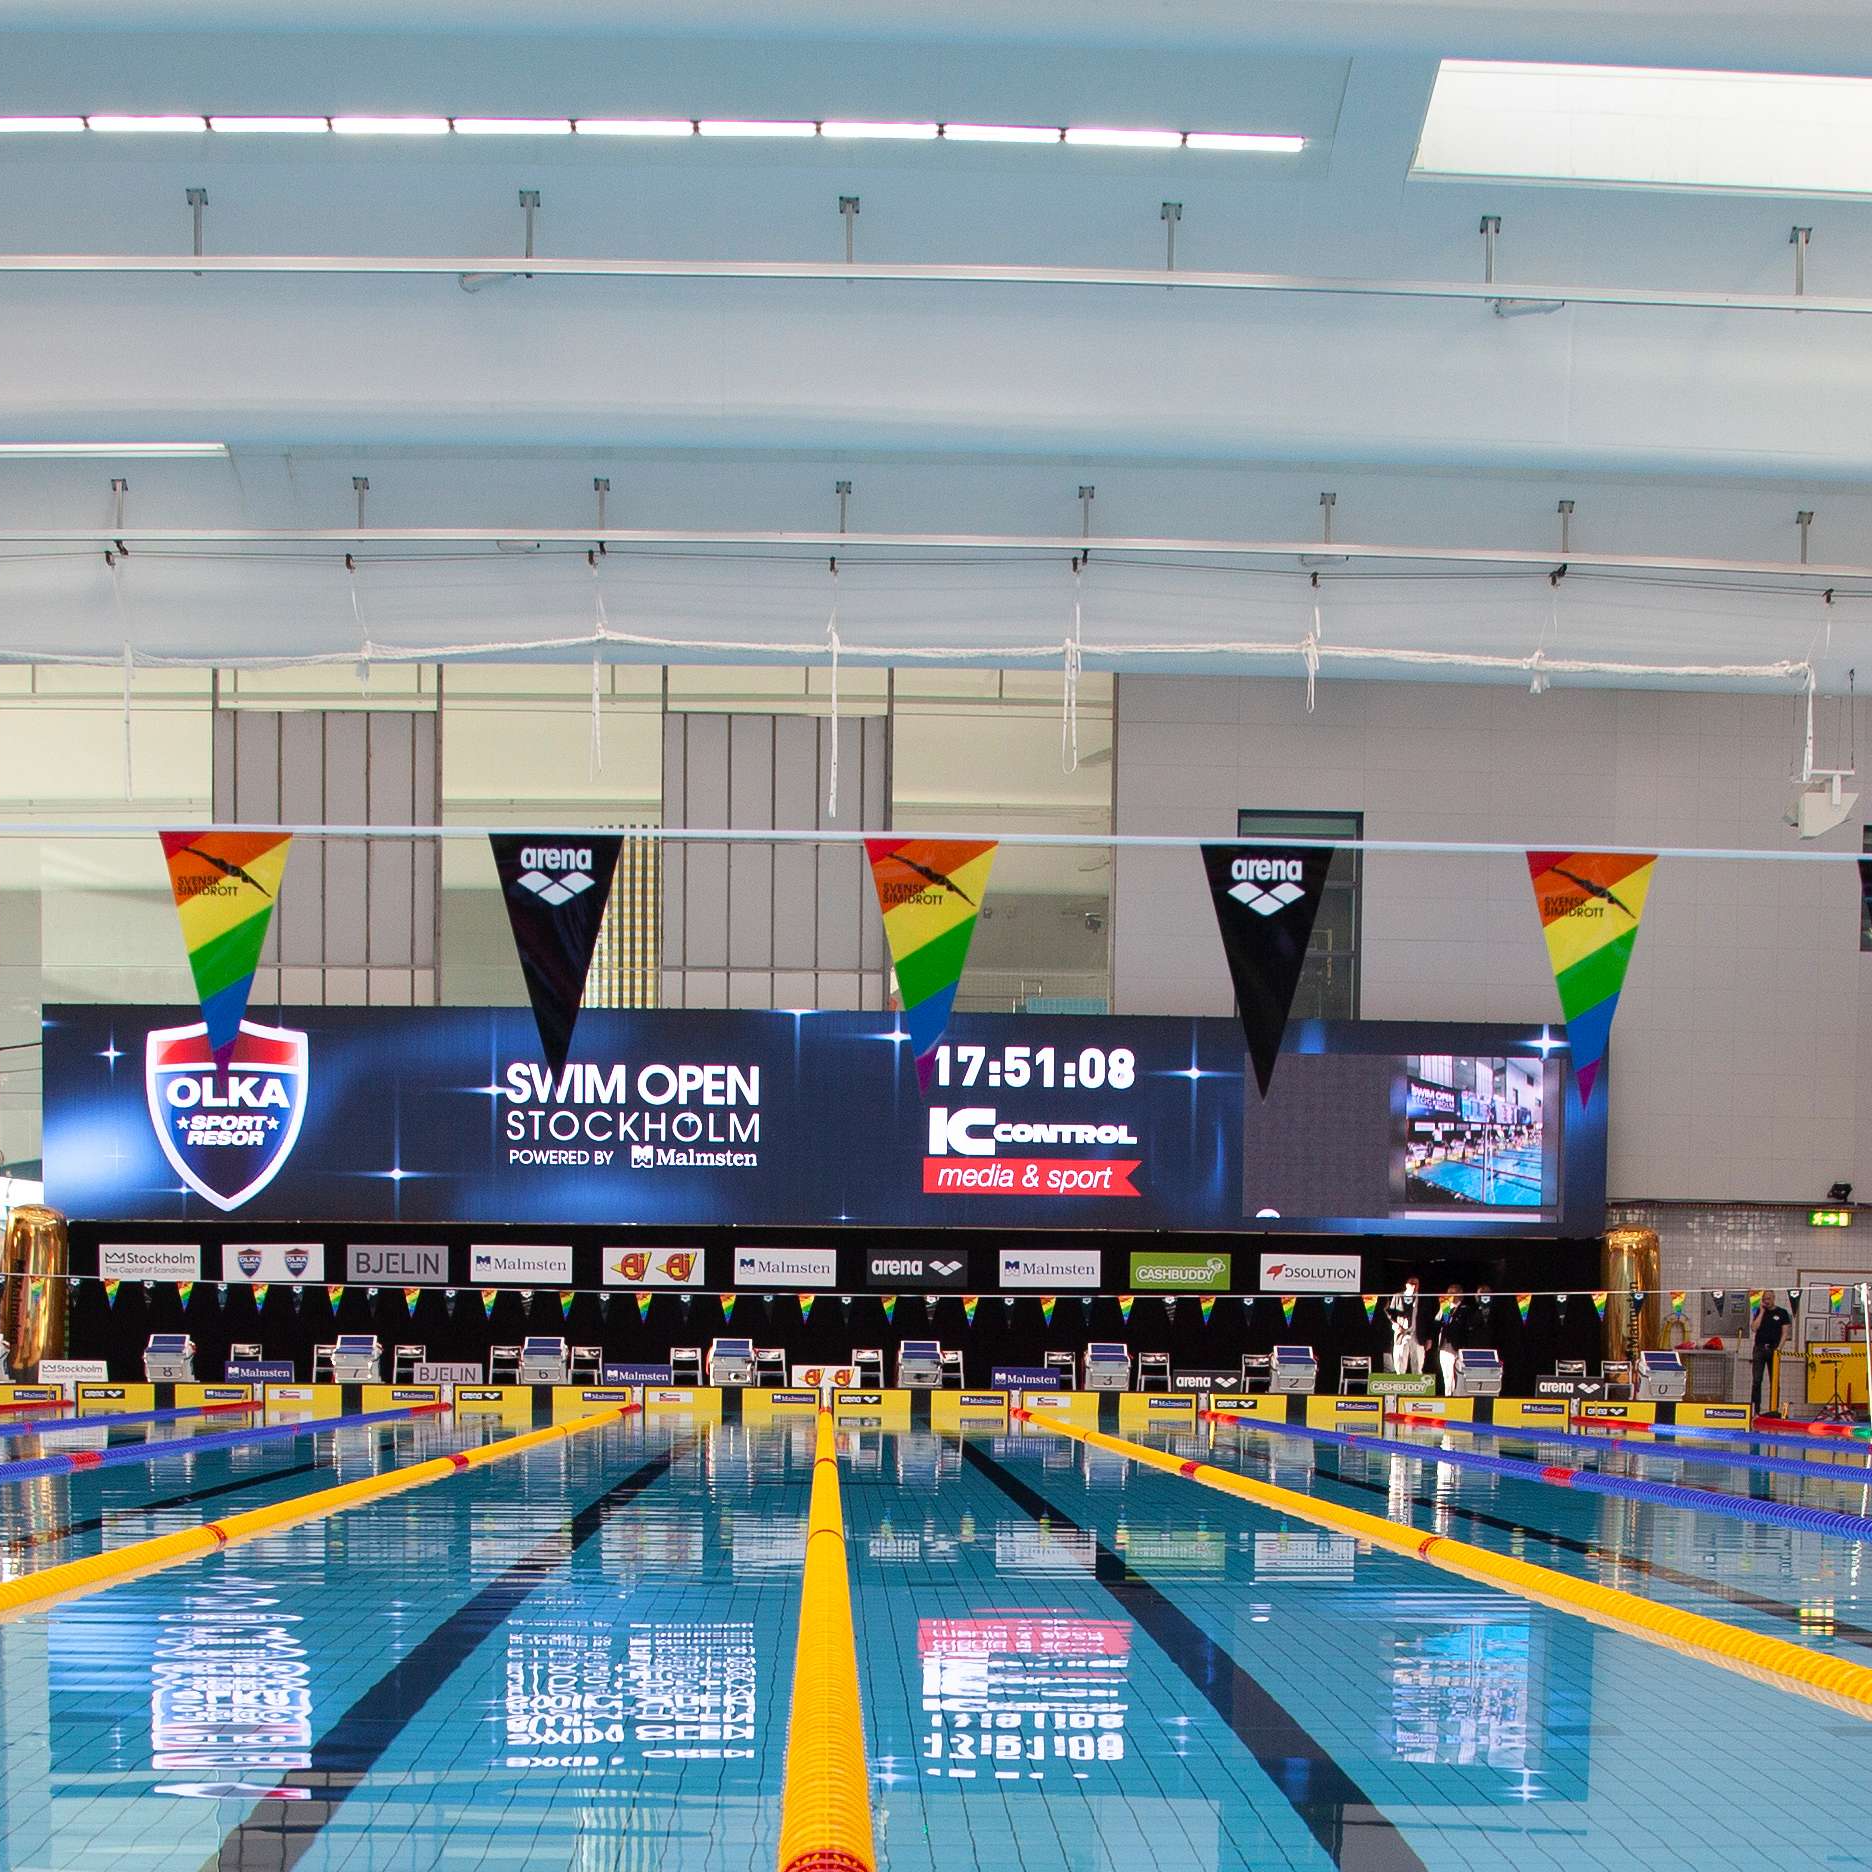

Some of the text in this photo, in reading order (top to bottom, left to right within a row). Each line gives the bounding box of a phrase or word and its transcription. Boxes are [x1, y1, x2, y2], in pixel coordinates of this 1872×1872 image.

[520, 847, 592, 869] arena
[1231, 859, 1303, 881] arena
[177, 876, 220, 886] SVENSK
[883, 882, 925, 893] SVENSK
[177, 886, 239, 897] SIMIDROTT
[883, 893, 943, 905] SIMIDROTT
[1544, 896, 1587, 906] SVENSK
[1544, 907, 1604, 918] SIMIDROTT
[935, 1045, 1135, 1089] 17:51:08
[505, 1062, 760, 1105] SWIM OPEN
[166, 1077, 290, 1108] OLKA
[189, 1115, 267, 1130] SPORT
[506, 1110, 760, 1143] STOCKHOLM
[187, 1131, 265, 1145] RESOR
[993, 1123, 1138, 1144] CONTROL
[509, 1148, 758, 1167] POWERED BY Malmsten
[937, 1163, 1113, 1193] media & sport
[127, 1252, 195, 1264] Stockholm
[356, 1252, 439, 1274] BJELIN
[495, 1257, 567, 1272] Malmsten
[106, 1266, 118, 1274] The
[758, 1260, 830, 1275] Malmsten
[871, 1259, 923, 1276] arena
[1023, 1262, 1095, 1275] Malmsten
[1137, 1266, 1214, 1281] CASHBUDDY
[57, 1364, 103, 1374] Stockholm
[240, 1368, 290, 1378] Malmsten
[419, 1367, 476, 1381] BJELIN
[539, 1369, 549, 1379] 6
[619, 1371, 669, 1381] Malmsten
[1007, 1373, 1057, 1384] Malmsten
[1176, 1376, 1211, 1388] arena
[1288, 1378, 1299, 1388] 2
[1370, 1380, 1426, 1393] CASHBUDDY
[1539, 1381, 1575, 1393] arena
